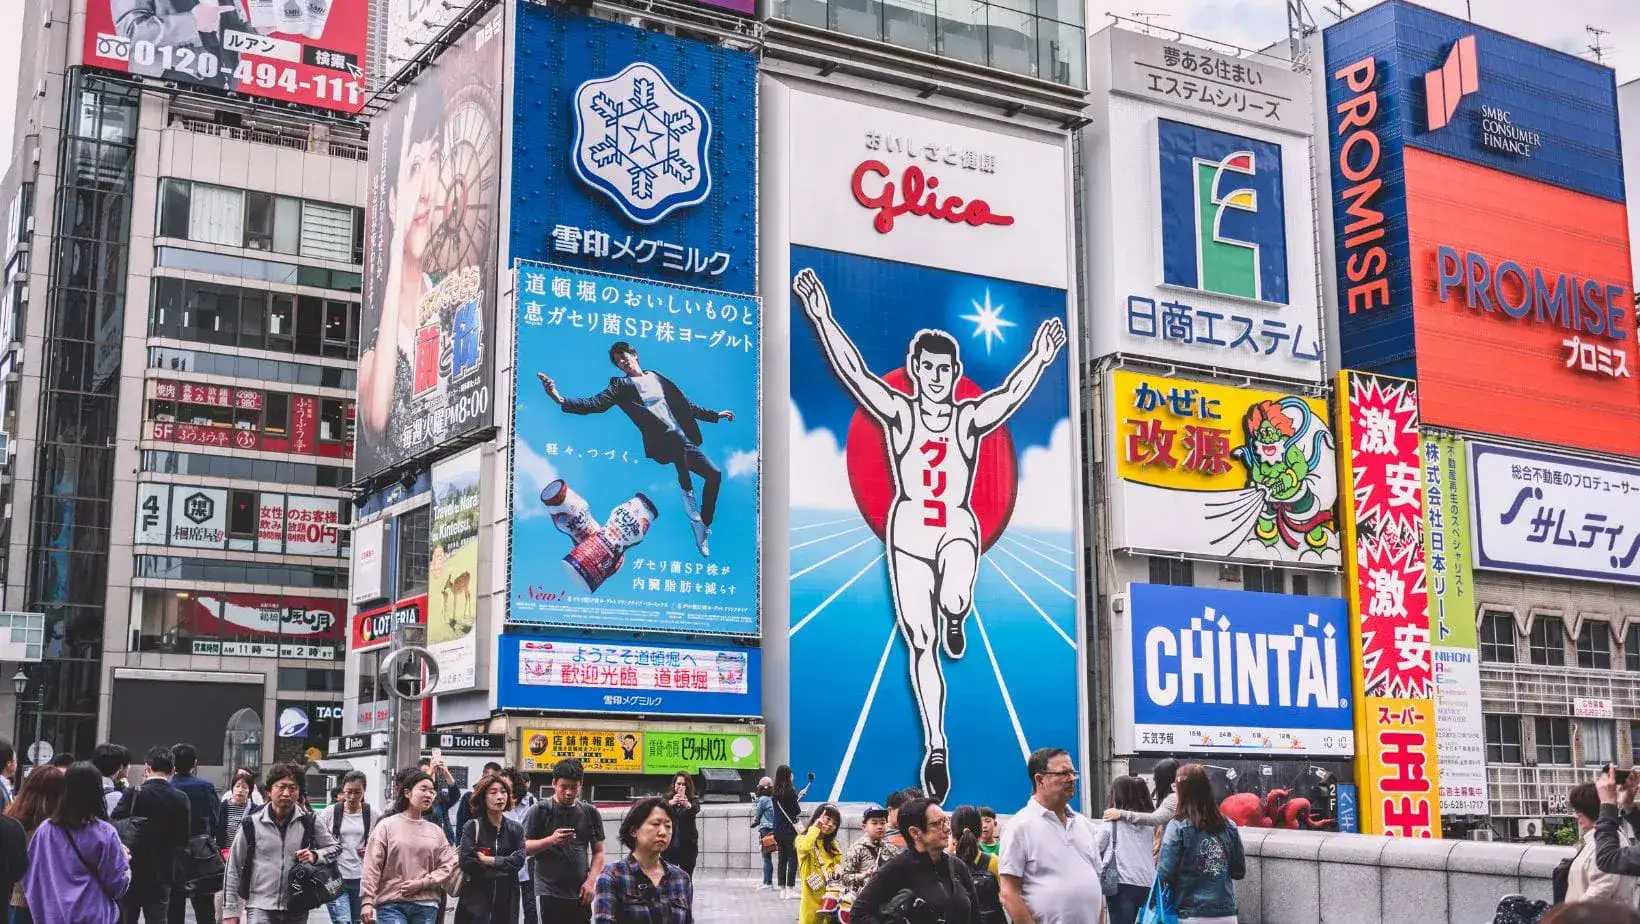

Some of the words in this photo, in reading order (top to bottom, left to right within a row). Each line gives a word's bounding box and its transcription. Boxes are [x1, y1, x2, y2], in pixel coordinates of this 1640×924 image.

[228, 38, 276, 54] ルアン
[134, 40, 359, 105] 0120-494-111
[1163, 45, 1263, 84] 夢ある住まい
[1147, 72, 1281, 121] エステムシリーズ
[1482, 104, 1511, 124] SMBC
[1483, 119, 1541, 146] CONSUMER
[1484, 133, 1531, 157] FINANCE
[851, 160, 1014, 233] Glico
[1335, 57, 1389, 315] PROMISE
[552, 223, 730, 276] 雪印メグミルク
[524, 272, 753, 326] 道頓堀のおいしいものと
[1437, 244, 1627, 339] PROMISE
[1127, 295, 1321, 360] 日商エステム
[1562, 336, 1630, 377] プロミス
[1134, 382, 1222, 421] かぜに
[154, 424, 174, 439] 5F
[1123, 417, 1233, 474] 改源
[1357, 406, 1421, 510] 激安
[919, 436, 950, 528] グリコ
[1510, 463, 1640, 494] 総合不動産のプロデューサー
[1424, 441, 1450, 641] 株式会社日本リート
[632, 558, 731, 580] ガセリ菌SP株が
[517, 585, 566, 602] New!
[632, 577, 737, 595] 内臓脂肪を減らす
[373, 608, 416, 636] LOTERIA
[1367, 566, 1430, 673] 激安
[194, 643, 220, 654] 営業時間
[572, 646, 698, 668] ようこそ道頓堀へ
[1145, 607, 1339, 709] CHINTAI
[1435, 651, 1471, 664] NIHON
[654, 669, 708, 690] 道頓堀
[317, 706, 344, 719] TAC
[603, 695, 662, 707] 雪印メグミルク
[1379, 707, 1425, 726] スーパー
[456, 736, 490, 748] Toilets
[553, 736, 615, 747] 店舗情報館
[682, 737, 727, 761] ピタットハウス
[1439, 799, 1484, 810] 06-6281-1717
